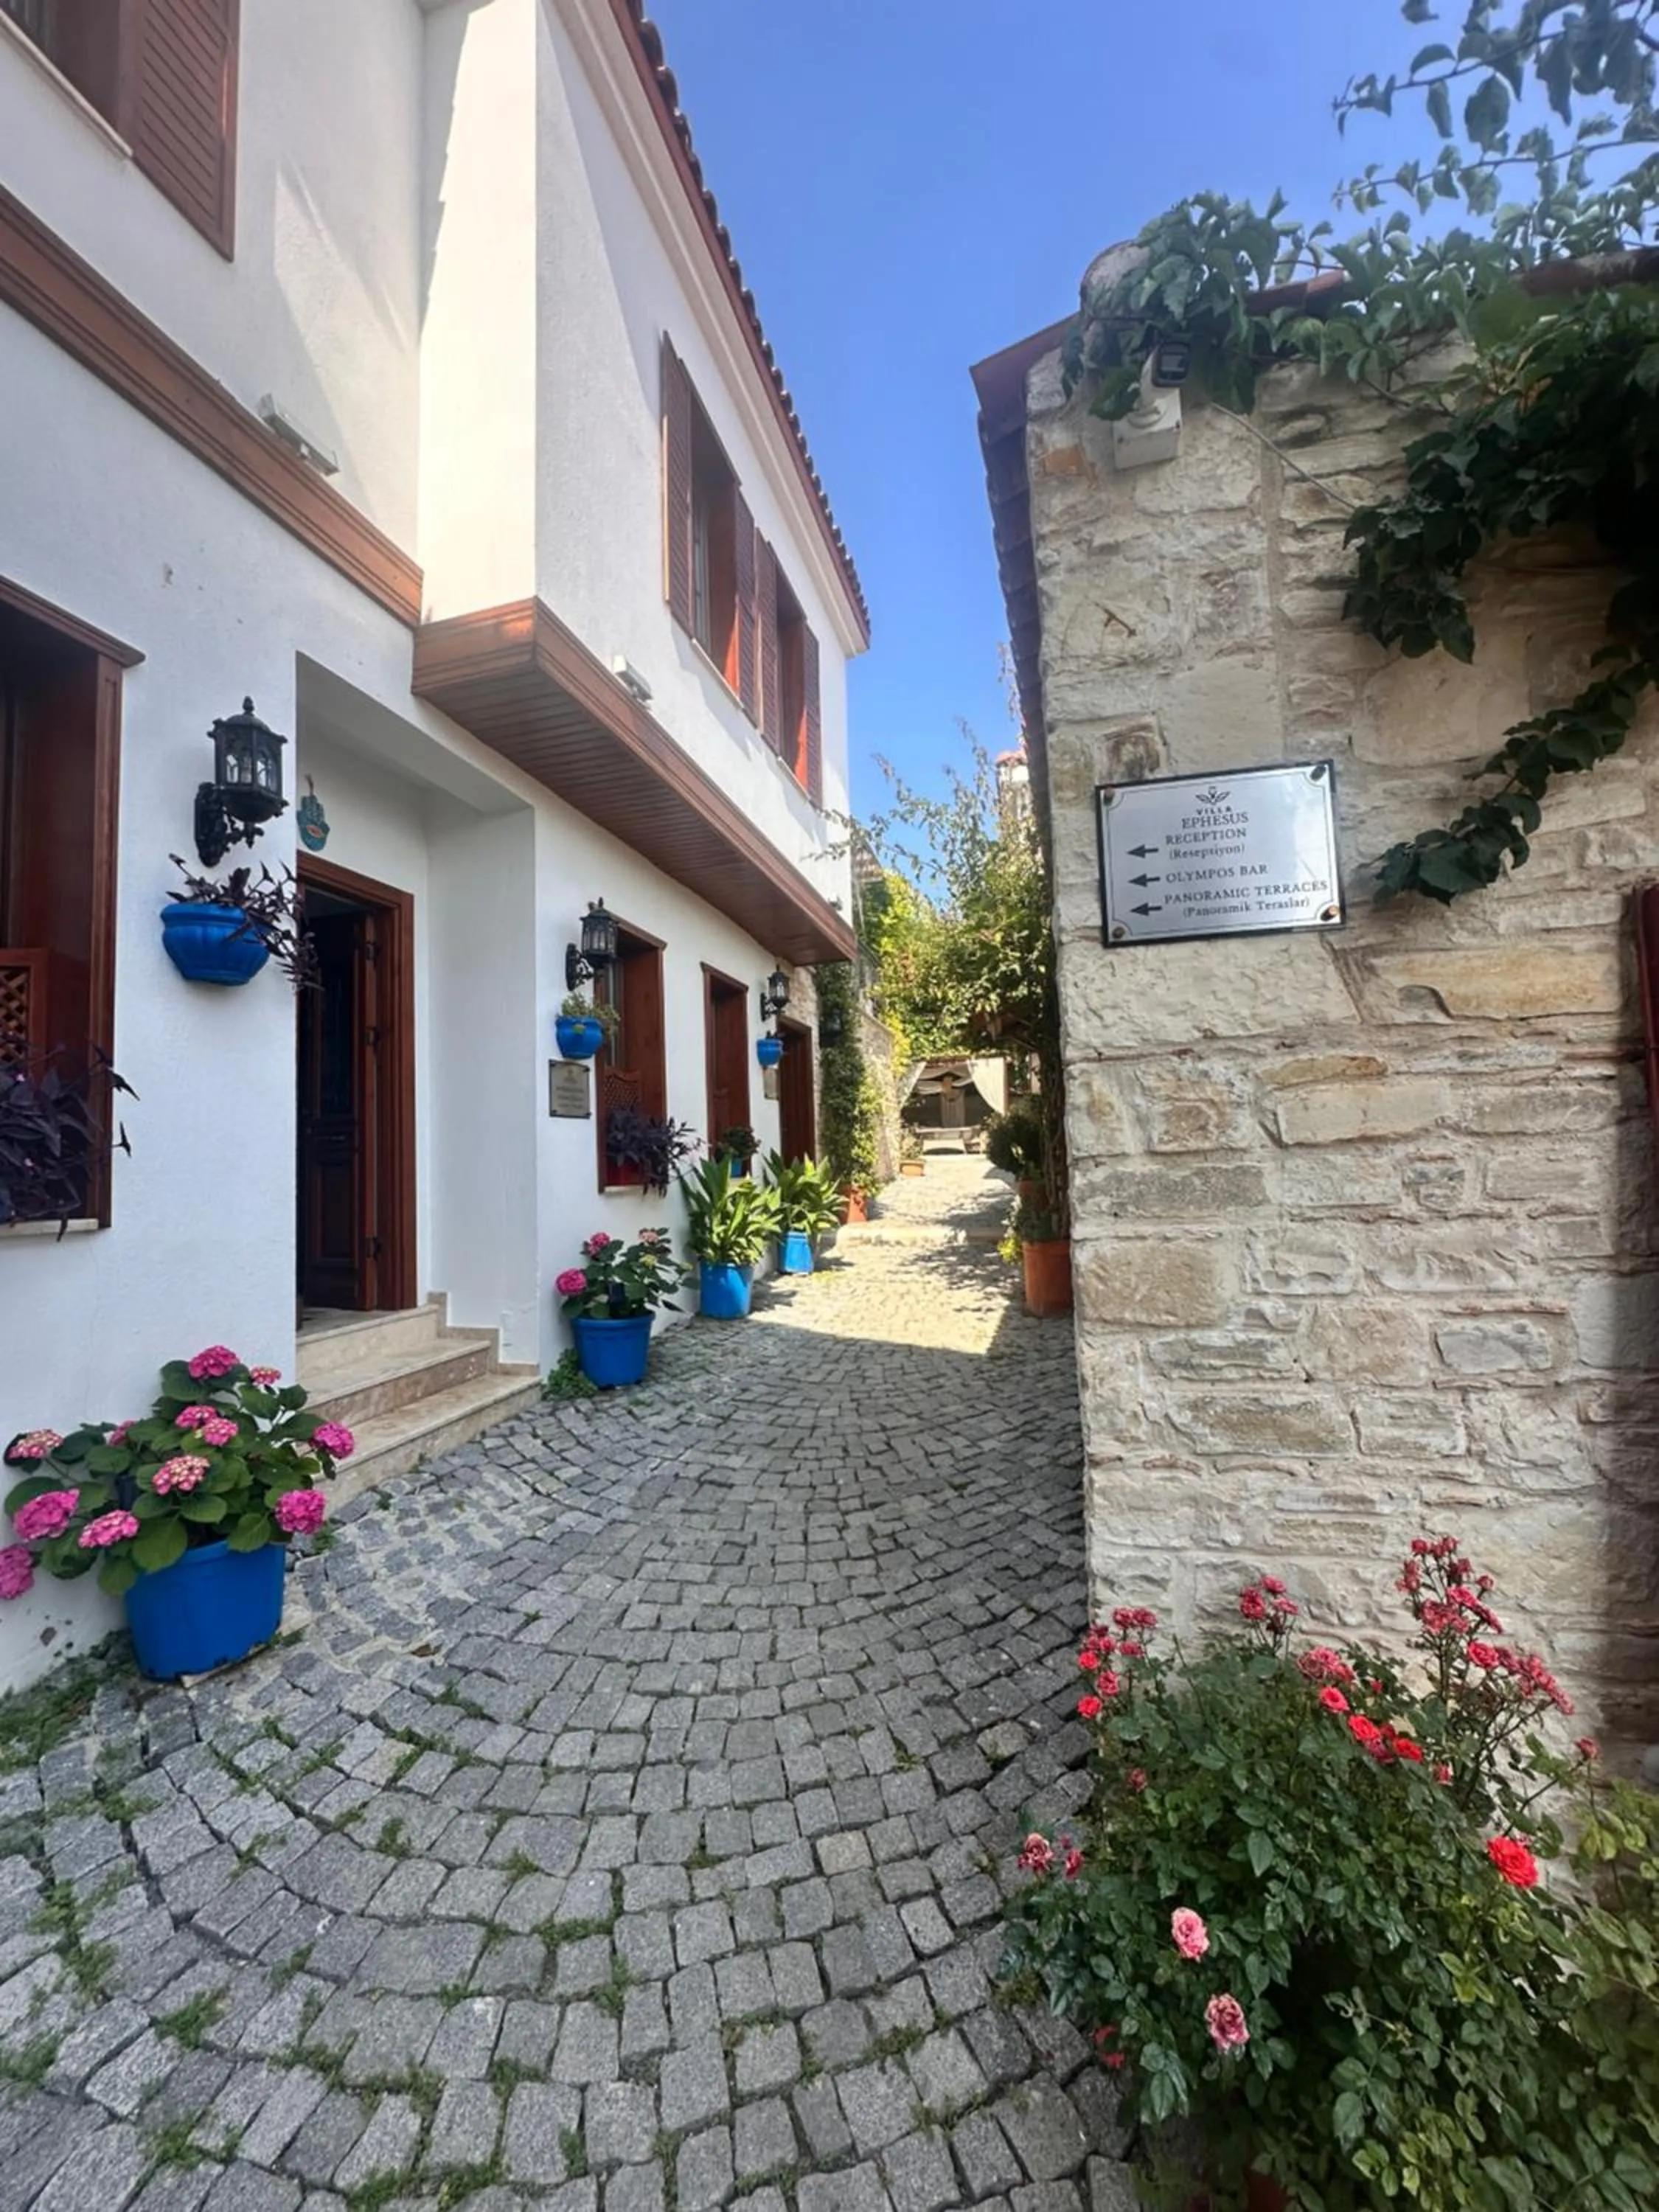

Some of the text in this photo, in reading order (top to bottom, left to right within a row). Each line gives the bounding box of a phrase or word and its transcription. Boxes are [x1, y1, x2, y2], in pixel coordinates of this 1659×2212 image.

[1196, 805, 1231, 815] VILLA
[1182, 812, 1249, 829] EPHESUS
[1166, 827, 1247, 845] RECEPTION
[1166, 864, 1268, 883] OLYMPOS BAR
[1164, 880, 1328, 905] PANORAMIC TERRACES
[1183, 897, 1310, 918] (Panoramik Teraslar)
